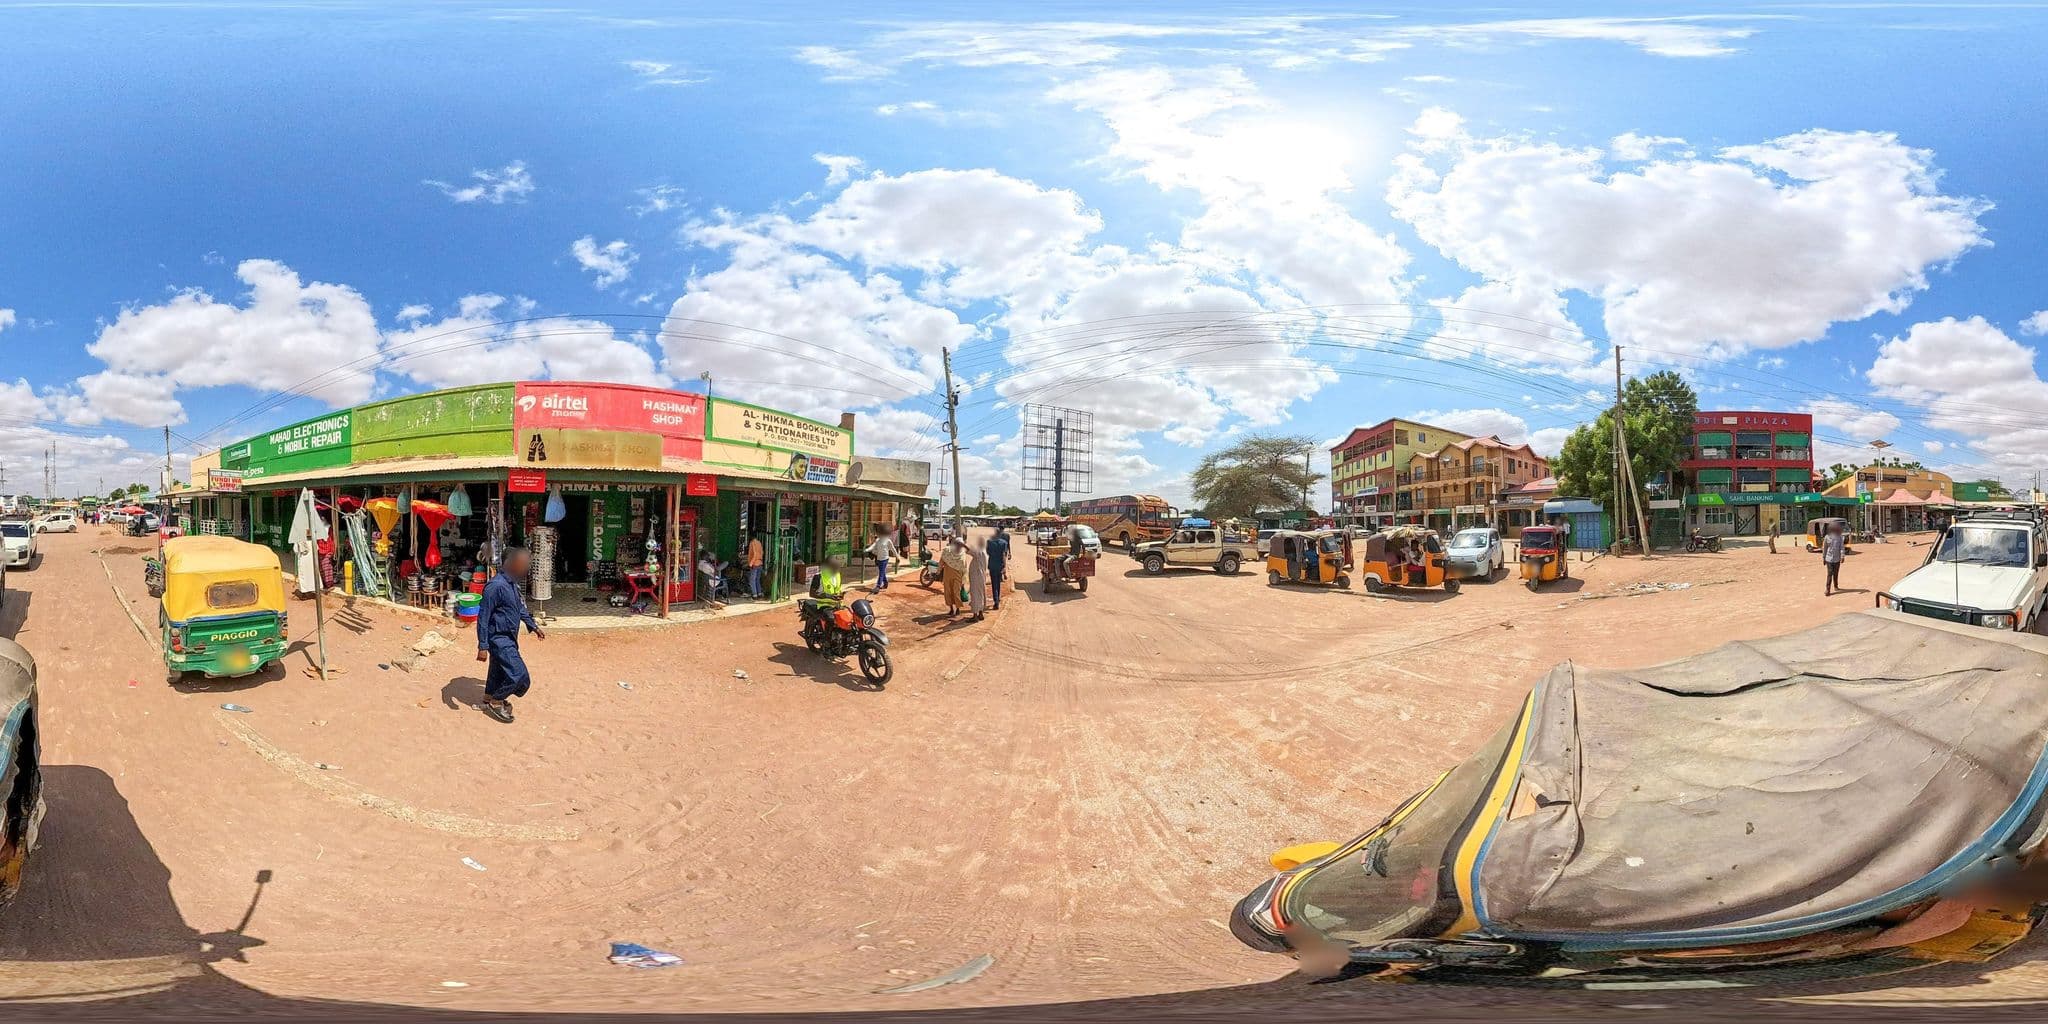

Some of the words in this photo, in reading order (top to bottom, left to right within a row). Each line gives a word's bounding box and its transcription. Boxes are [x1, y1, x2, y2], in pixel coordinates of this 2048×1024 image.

[542, 393, 588, 411] airtel
[642, 400, 697, 415] HASHMAT
[552, 409, 586, 420] money
[652, 414, 683, 425] SHOP
[1744, 417, 1788, 426] PLAZA
[269, 431, 291, 445] MAHAD
[293, 415, 349, 439] ELECTRONICS
[744, 420, 751, 429] &
[755, 420, 820, 443] STATIONARIES
[822, 436, 836, 446] LTD
[762, 413, 794, 427] HIKMA
[796, 421, 840, 438] BOOKSHOP
[277, 444, 283, 455] &
[284, 438, 309, 453] MOBILE
[311, 431, 342, 448] REPAIR
[211, 629, 258, 642] PIAGGIO
